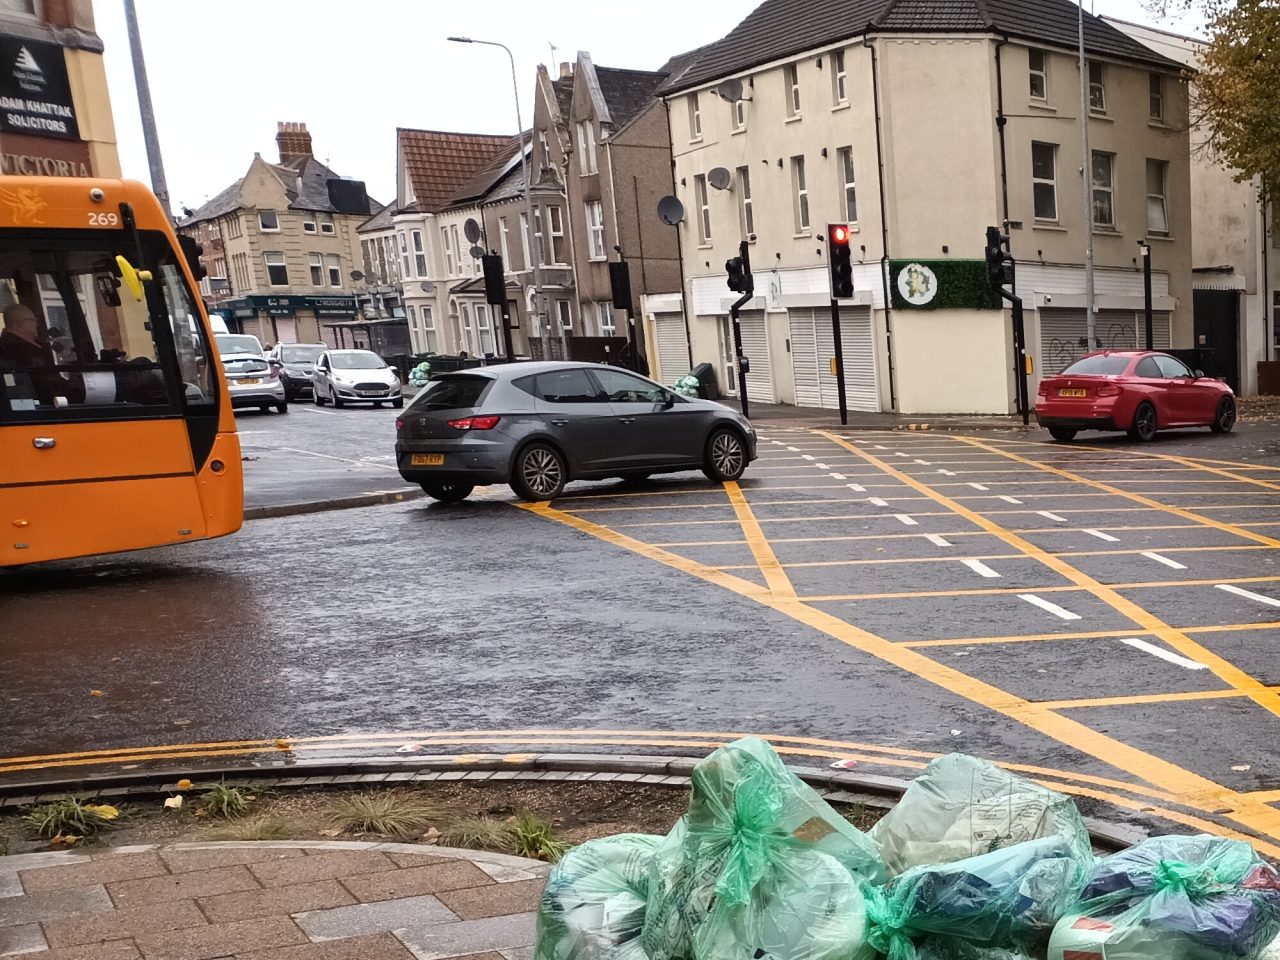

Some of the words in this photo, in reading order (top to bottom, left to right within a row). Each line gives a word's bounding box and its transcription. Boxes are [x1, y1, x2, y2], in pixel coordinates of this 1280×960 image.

[26, 100, 73, 118] KHATTAK
[7, 113, 68, 133] SOLICITORS
[0, 153, 89, 177] VICTORIA
[88, 212, 118, 226] 269
